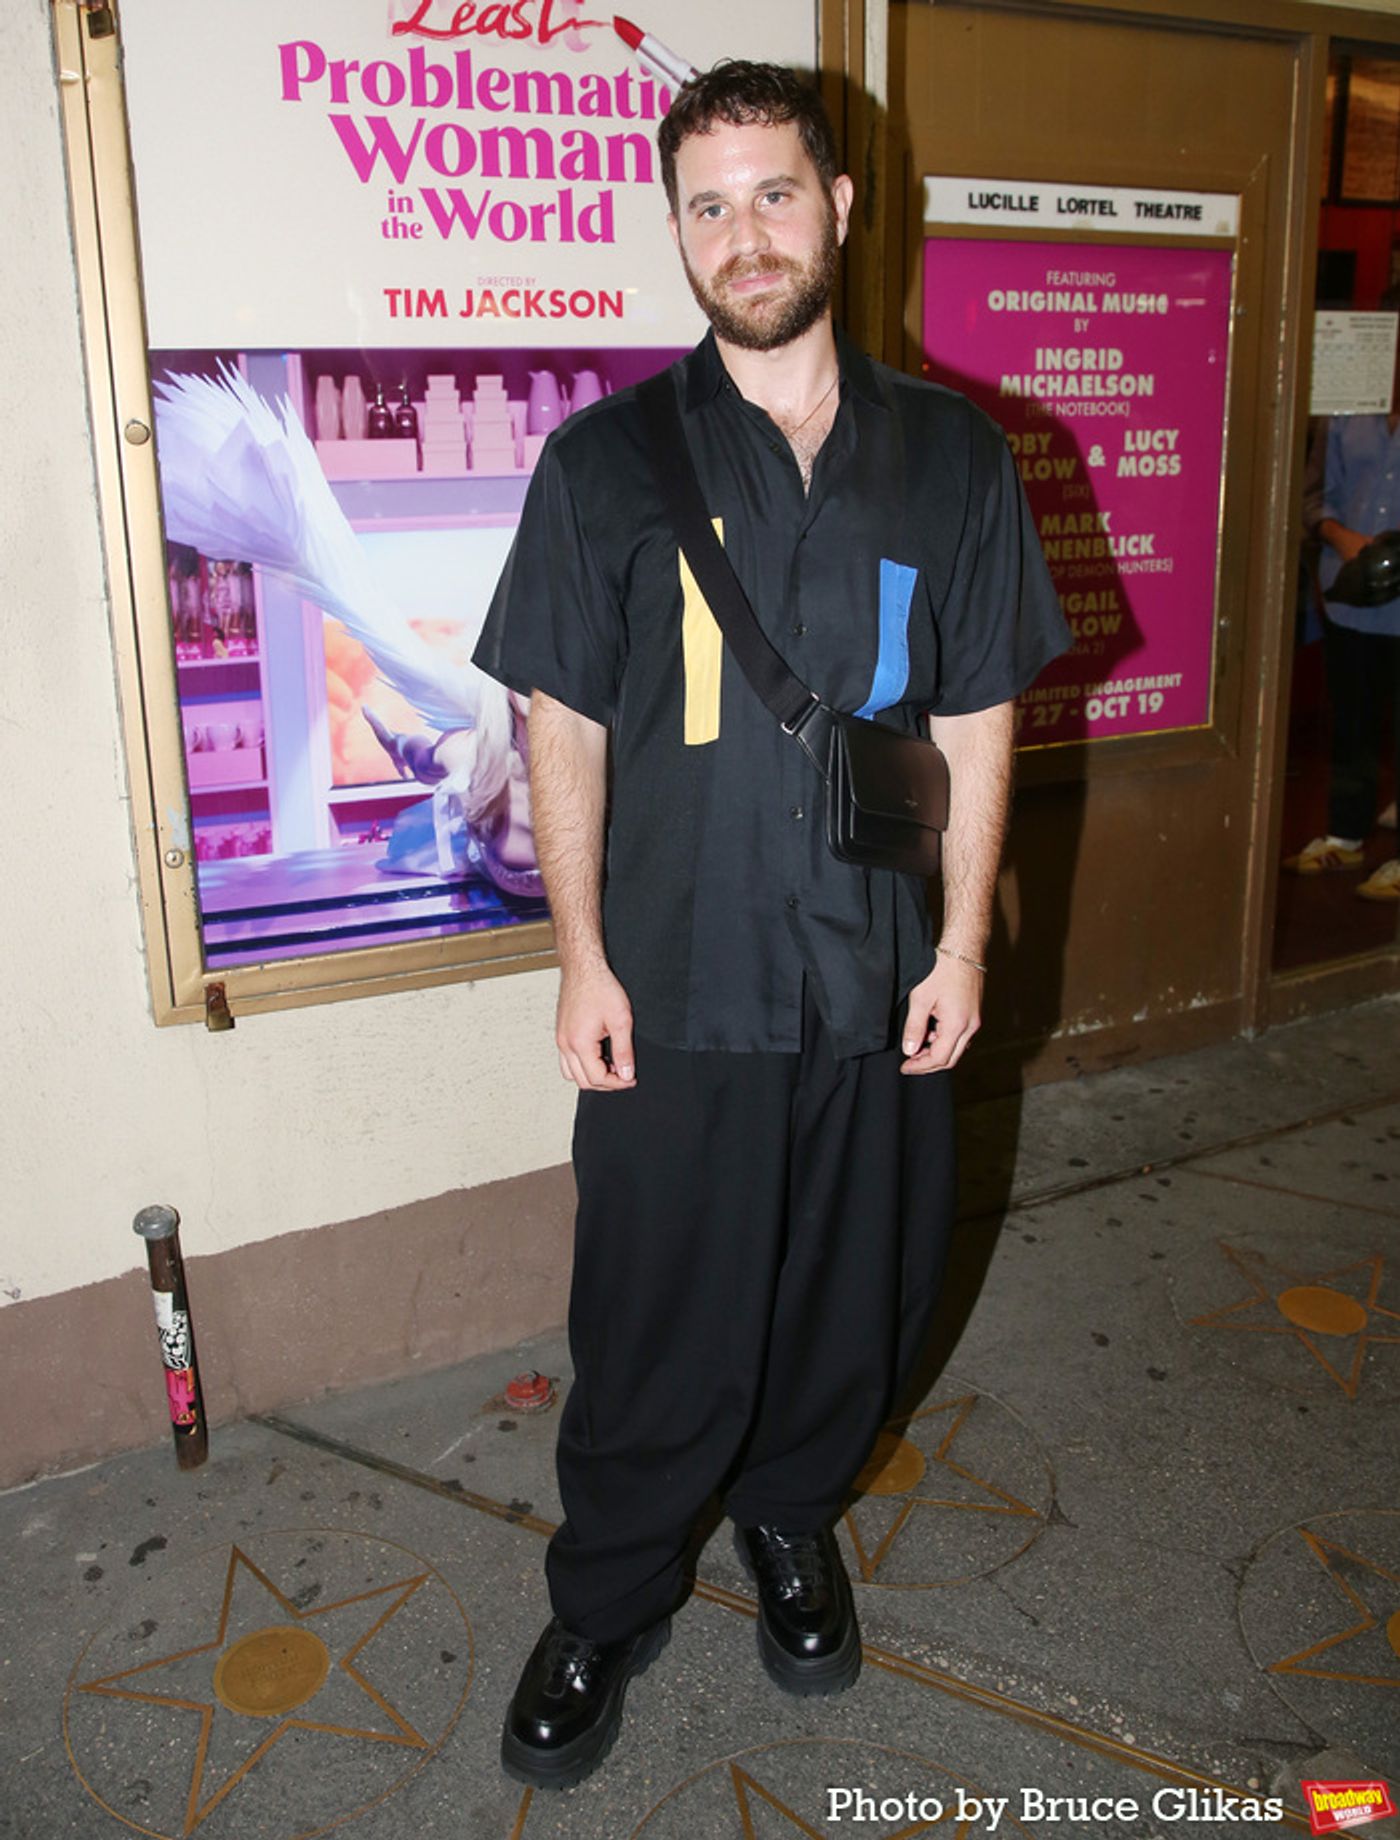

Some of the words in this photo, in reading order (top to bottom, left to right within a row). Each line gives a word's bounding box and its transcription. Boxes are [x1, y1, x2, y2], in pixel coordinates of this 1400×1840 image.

[328, 114, 654, 184] Woman
[387, 190, 414, 213] in
[968, 193, 1039, 212] LUCILLE
[1056, 197, 1118, 217] LORTEL
[1135, 201, 1203, 221] THEATRE
[381, 217, 423, 240] the
[420, 188, 615, 243] World
[477, 276, 523, 287] DIRECTED
[525, 277, 536, 287] BY
[1046, 271, 1116, 287] FEATURING
[384, 289, 449, 318] TIM
[459, 289, 623, 319] JACKSON
[988, 290, 1098, 313] ORIGINAL
[1074, 317, 1090, 333] BY
[1035, 348, 1124, 371] INGRID
[1000, 374, 1155, 398] MICHAELSON
[1055, 401, 1130, 418] NOTEBOOK)
[1007, 431, 1053, 456] OBY
[1124, 429, 1179, 452] LUCY
[1088, 445, 1106, 467] &
[1117, 454, 1181, 477] MOSS
[1021, 457, 1077, 481] LOW
[1040, 512, 1111, 536] MARK
[1043, 534, 1155, 561] NENBLICK
[1118, 558, 1173, 574] HUNTERS)
[1058, 589, 1120, 614] IGAIL
[1070, 613, 1123, 638] LOW
[1020, 683, 1081, 704] LIMITED
[1084, 673, 1183, 698] ENGAGEMENT
[1031, 703, 1065, 728] 27
[1084, 696, 1131, 721] OCT
[1138, 692, 1165, 715] 19
